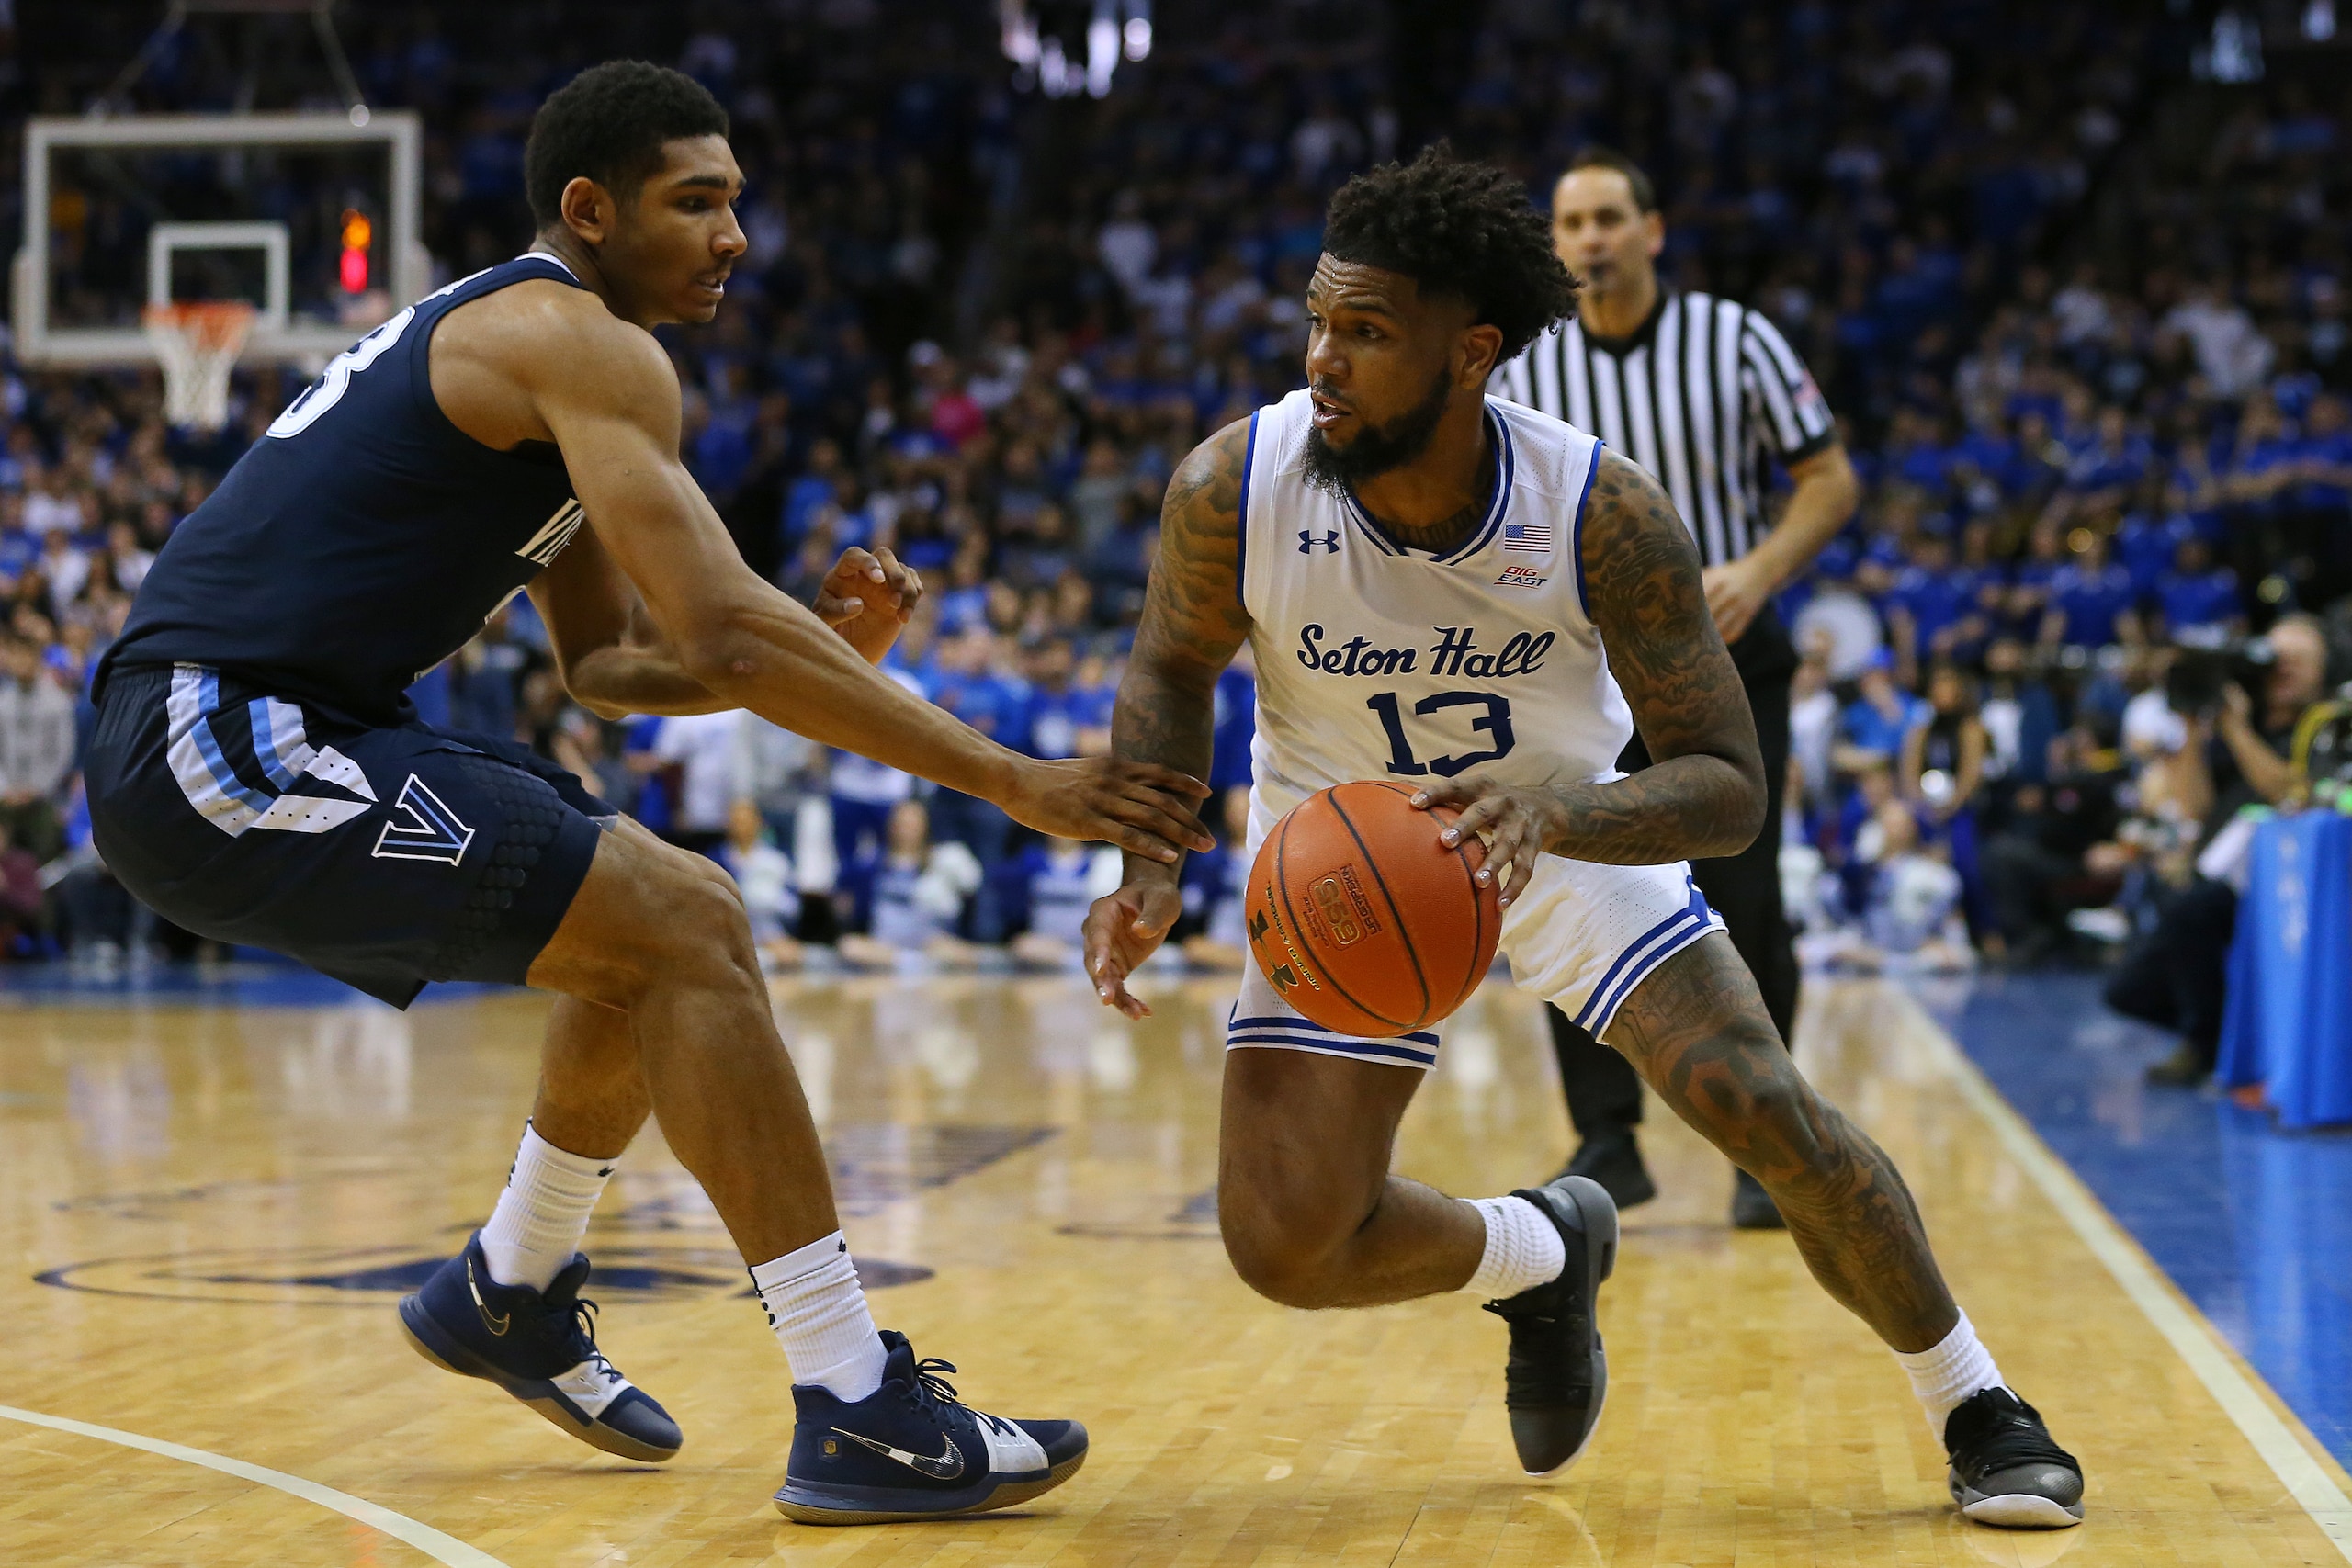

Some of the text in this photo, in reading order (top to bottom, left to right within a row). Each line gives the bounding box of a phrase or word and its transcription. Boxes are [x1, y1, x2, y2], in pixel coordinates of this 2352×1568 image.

[1498, 574, 1548, 586] EAST
[1504, 566, 1540, 576] BIG
[1296, 623, 1555, 678] Seton Hall
[1366, 691, 1516, 778] 13
[371, 773, 475, 867] V
[1265, 886, 1321, 991] UNDER ARMOUR
[1314, 878, 1360, 944] 695
